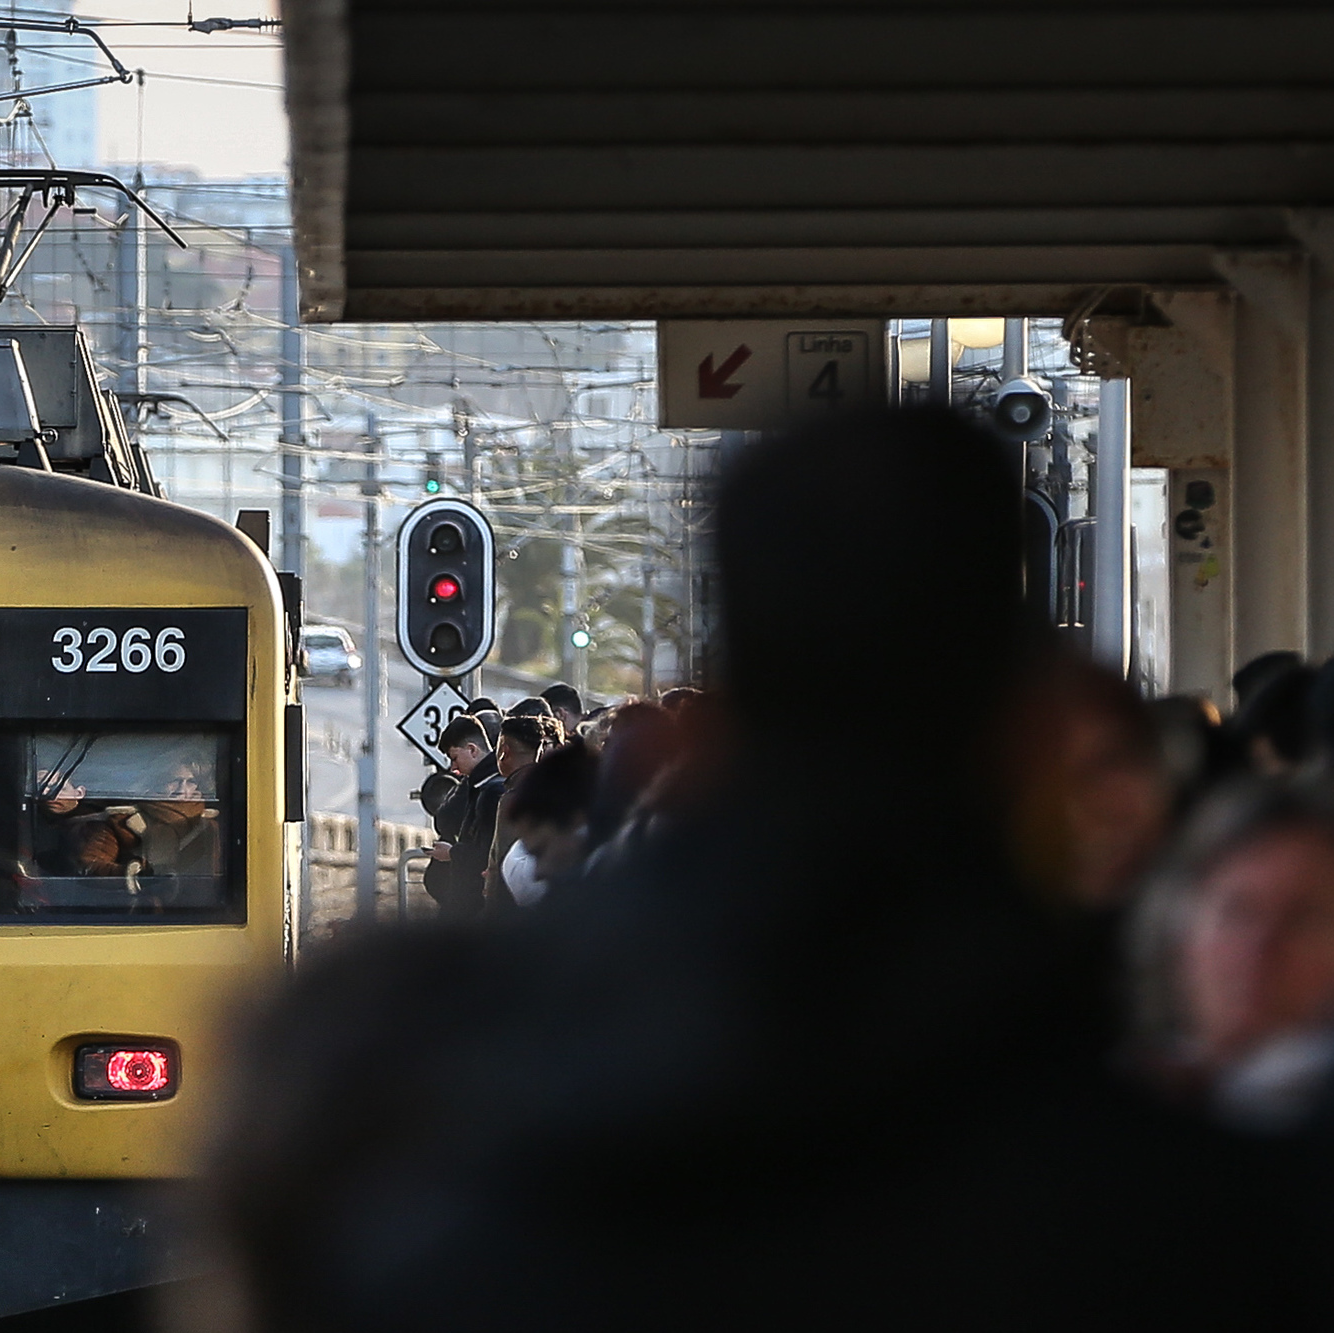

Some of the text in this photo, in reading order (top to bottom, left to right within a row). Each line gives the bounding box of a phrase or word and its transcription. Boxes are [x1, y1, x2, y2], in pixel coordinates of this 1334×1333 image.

[800, 335, 852, 353] Linha
[808, 361, 845, 405] 4
[51, 627, 185, 673] 3266
